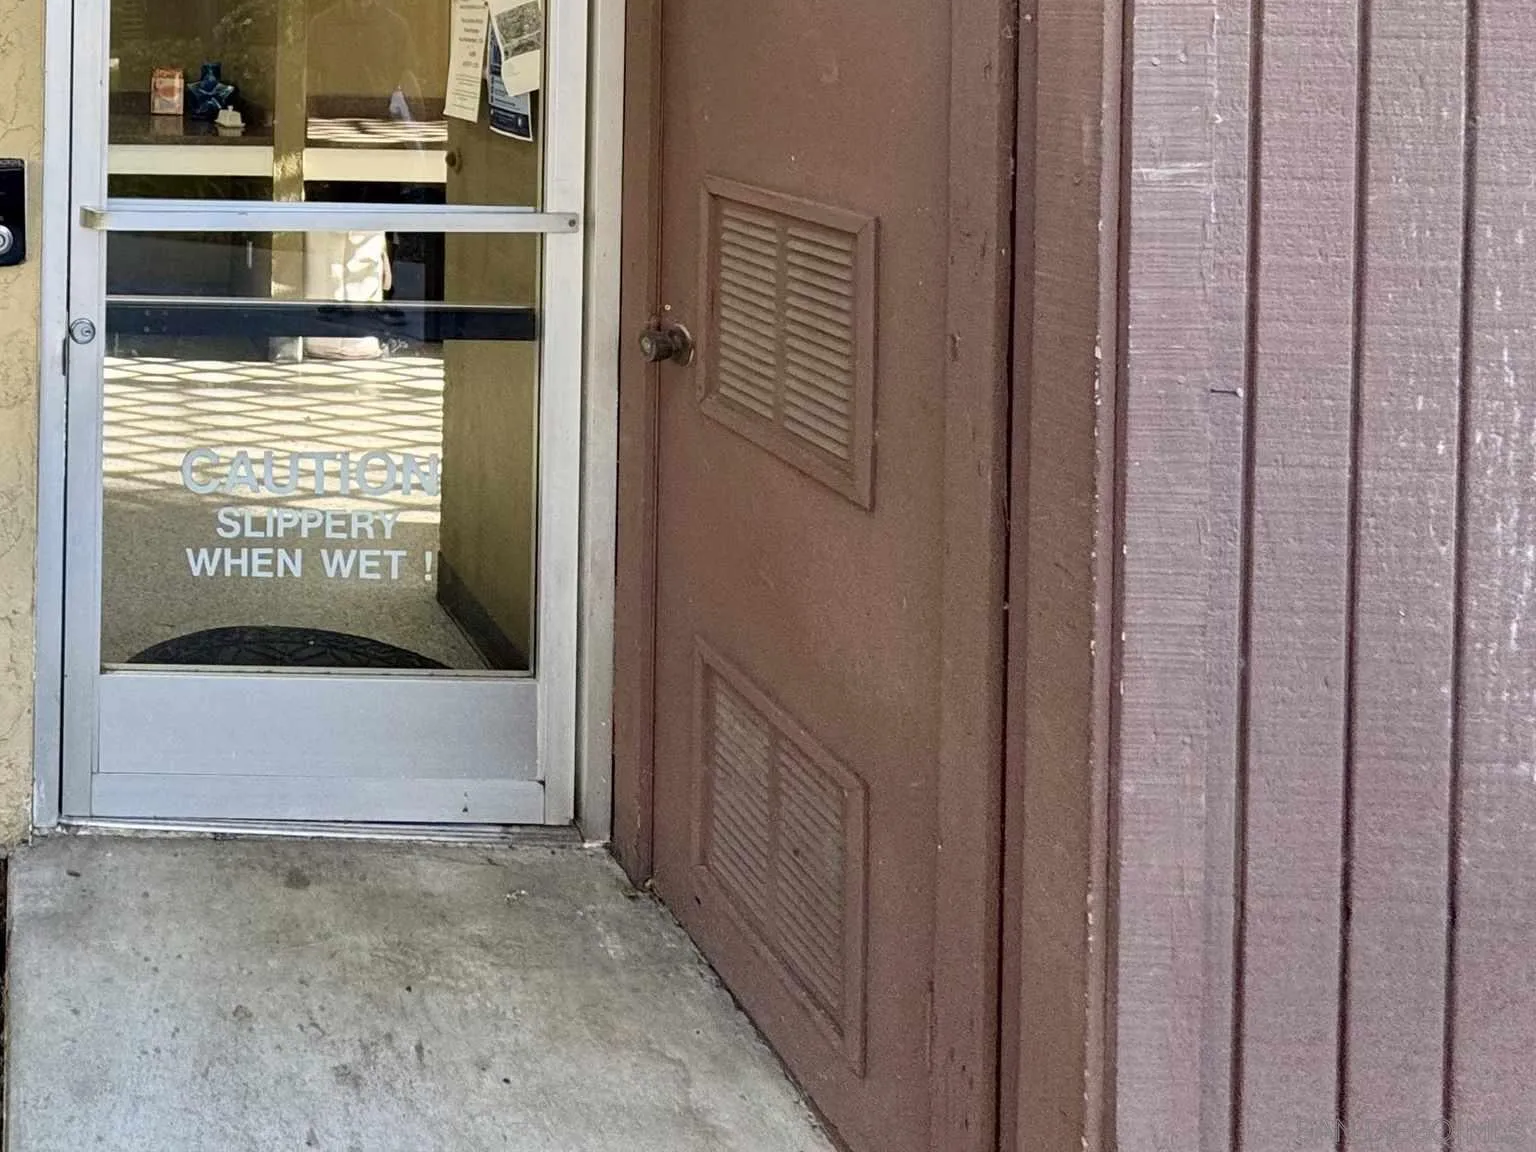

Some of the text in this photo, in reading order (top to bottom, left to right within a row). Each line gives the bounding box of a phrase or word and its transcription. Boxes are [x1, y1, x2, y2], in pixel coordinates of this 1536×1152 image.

[181, 448, 440, 496] CAUTION
[216, 507, 400, 539] SLIPPERY
[185, 548, 432, 581] WHEN WET !
